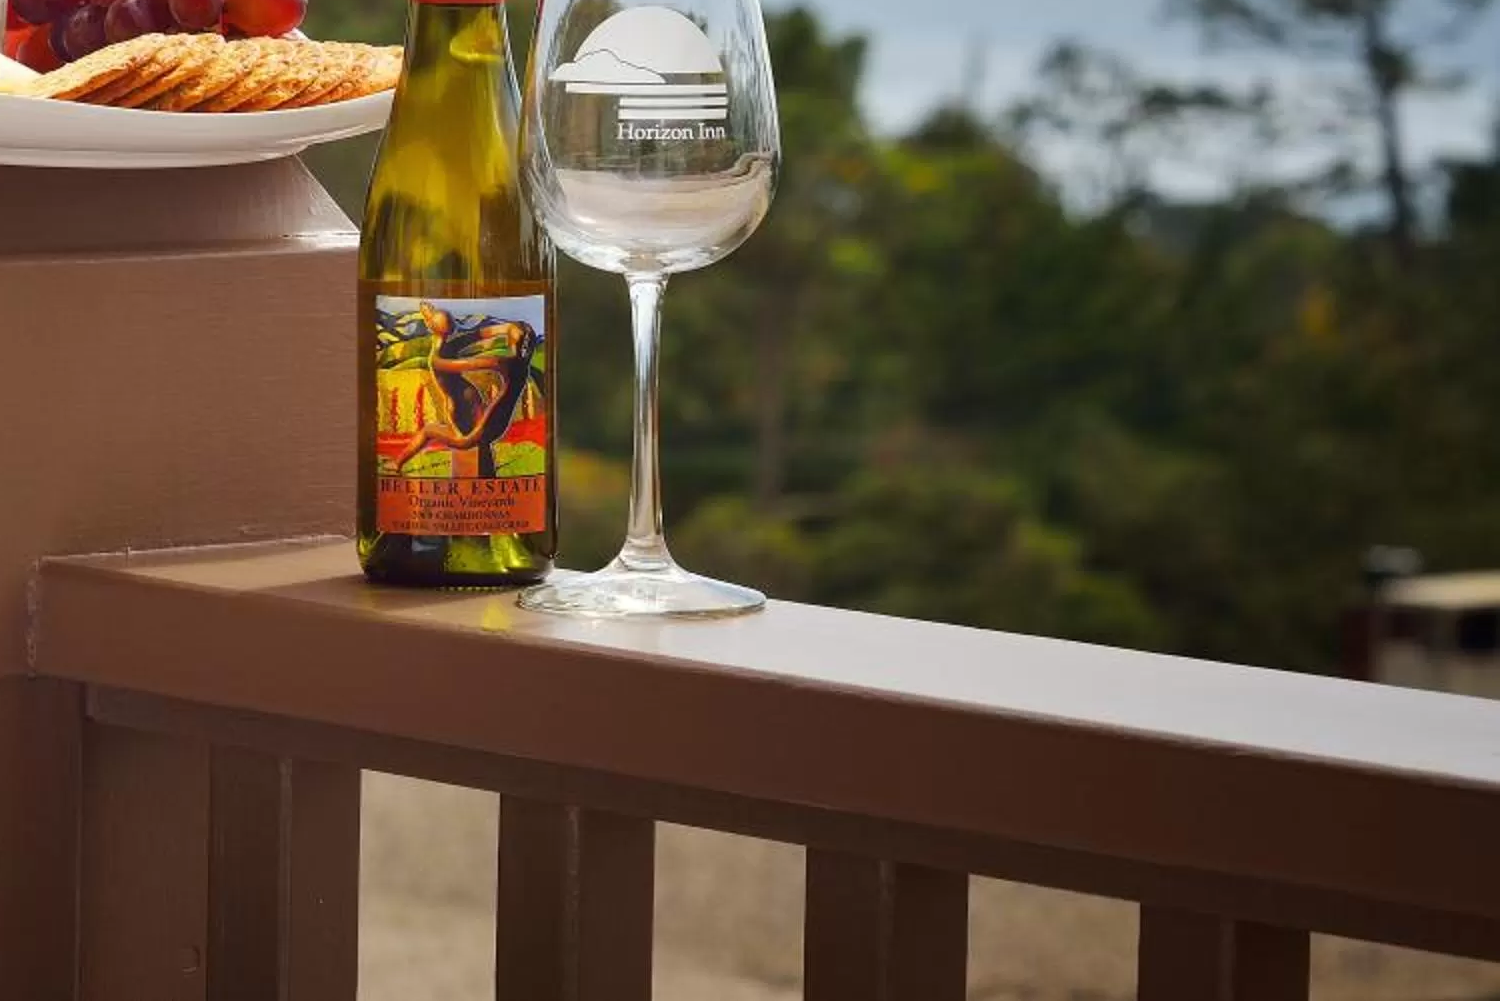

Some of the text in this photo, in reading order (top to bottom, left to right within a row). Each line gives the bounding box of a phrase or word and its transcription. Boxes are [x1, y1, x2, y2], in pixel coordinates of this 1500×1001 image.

[617, 122, 726, 140] Horizon Inn
[380, 479, 541, 495] HELLER ESTATE
